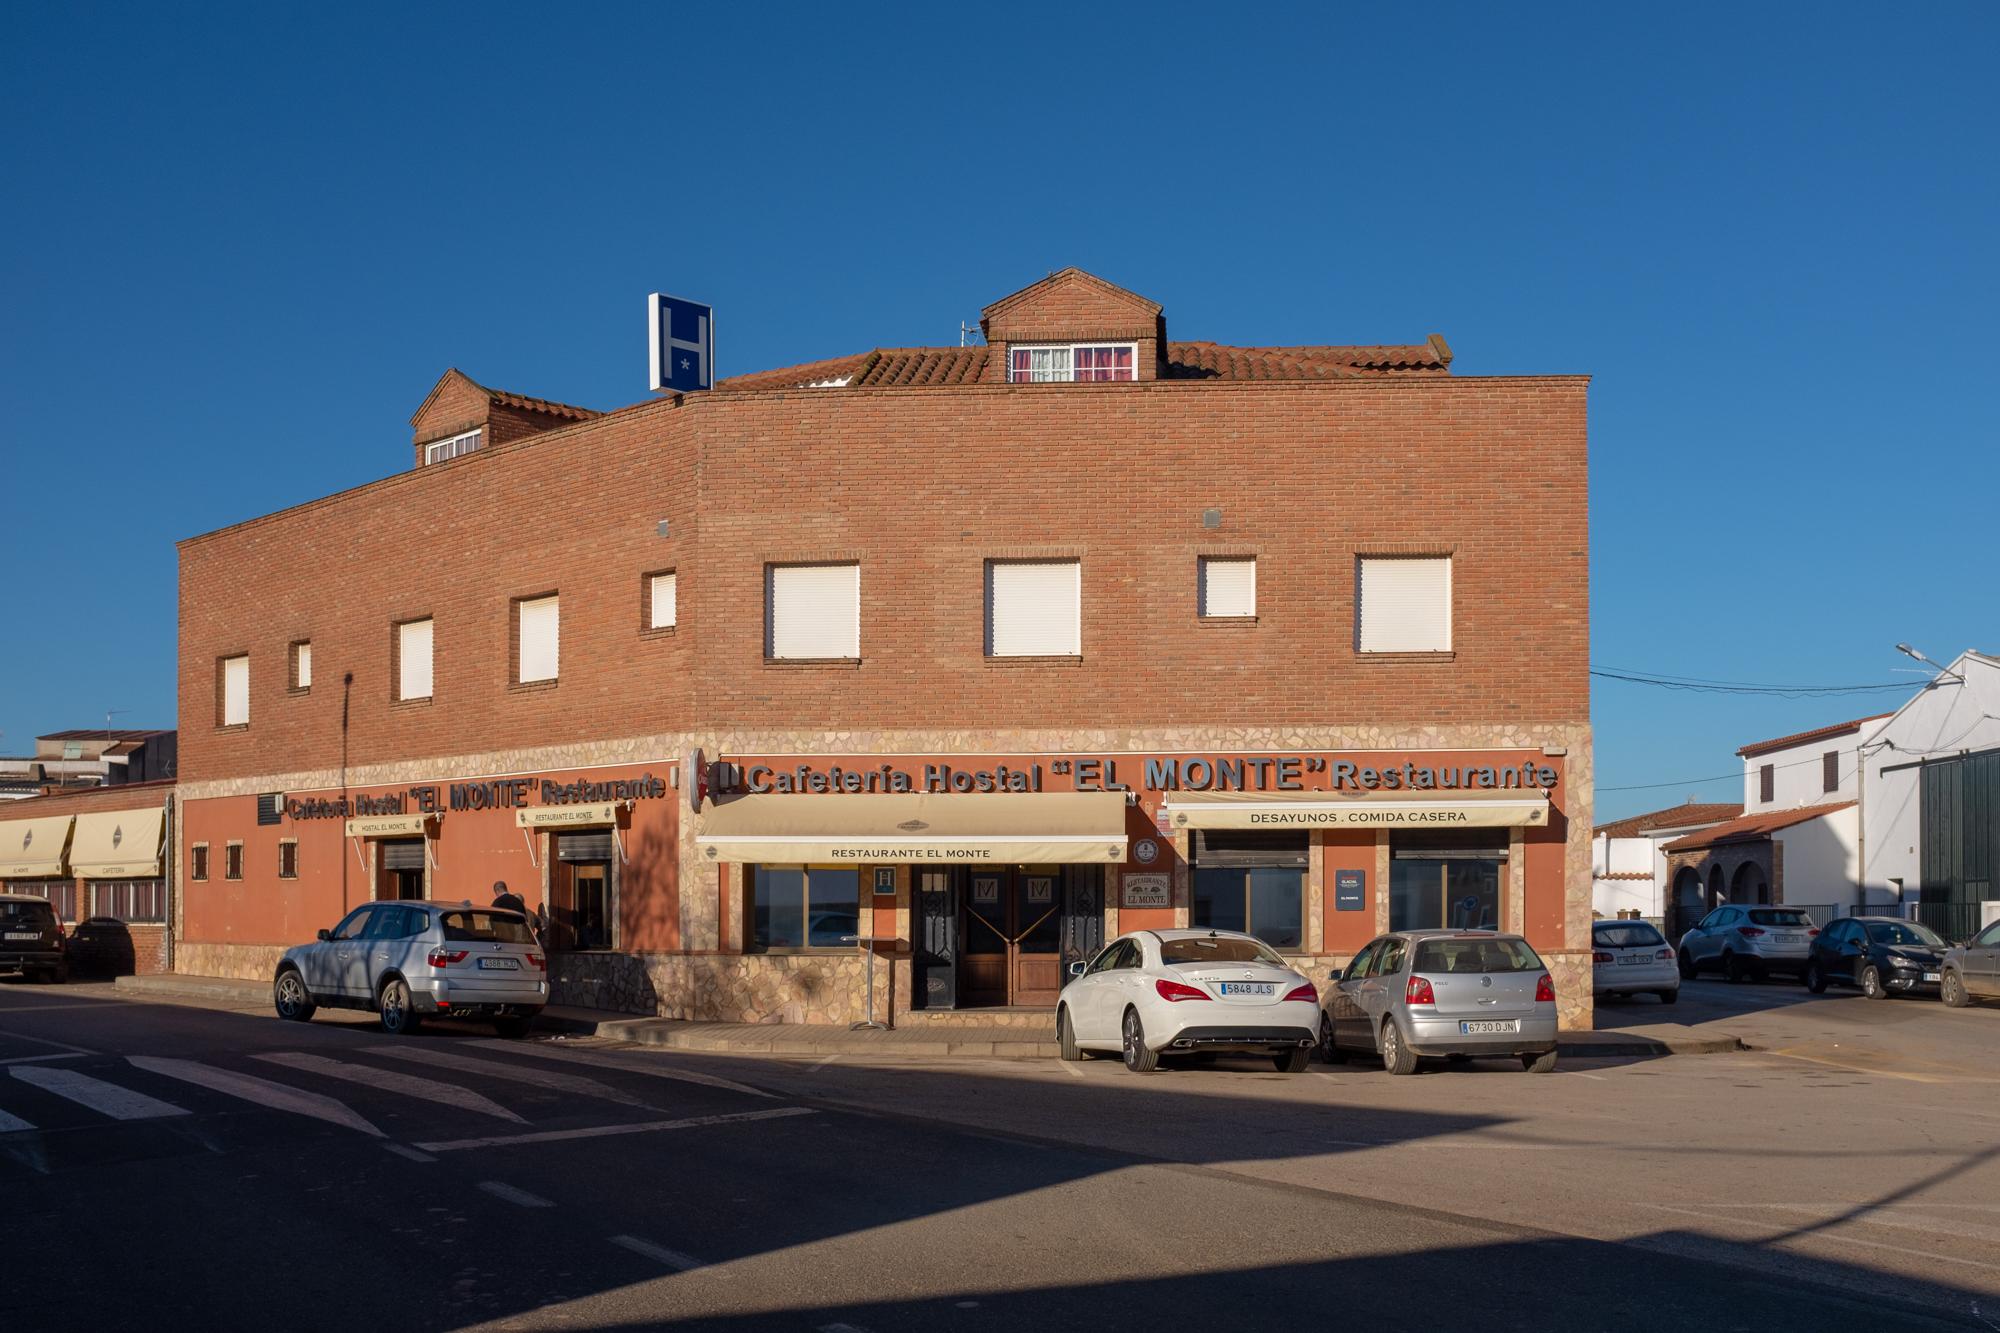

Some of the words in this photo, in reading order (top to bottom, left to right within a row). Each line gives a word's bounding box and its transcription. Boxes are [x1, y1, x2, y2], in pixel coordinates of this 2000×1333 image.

[663, 307, 707, 387] H
[748, 764, 909, 793] Cafetería
[923, 763, 1041, 793] Hostal
[1332, 760, 1557, 789] Restaurante
[355, 791, 407, 816] Hostal
[541, 772, 666, 806] Restaurante
[535, 812, 568, 822] RESTAURANTE
[568, 811, 575, 820] EL
[575, 811, 593, 820] MONTE
[1250, 812, 1337, 823] DESAYUNOS
[1348, 812, 1405, 822] COMIDA
[1408, 811, 1467, 822] CASERA
[361, 823, 380, 832] HOSTAL
[381, 823, 388, 831] EL
[388, 822, 407, 831] MONTE
[831, 849, 923, 858] RESTAURANTE
[927, 849, 942, 858] EL
[946, 849, 990, 858] MONTE
[879, 871, 891, 886] H
[1128, 895, 1138, 904] EL
[1139, 895, 1166, 904] MONTE
[1226, 984, 1252, 994] 5848
[1254, 984, 1272, 994] JLS
[1468, 1023, 1493, 1033] 6730
[1495, 1022, 1514, 1032] DJN
